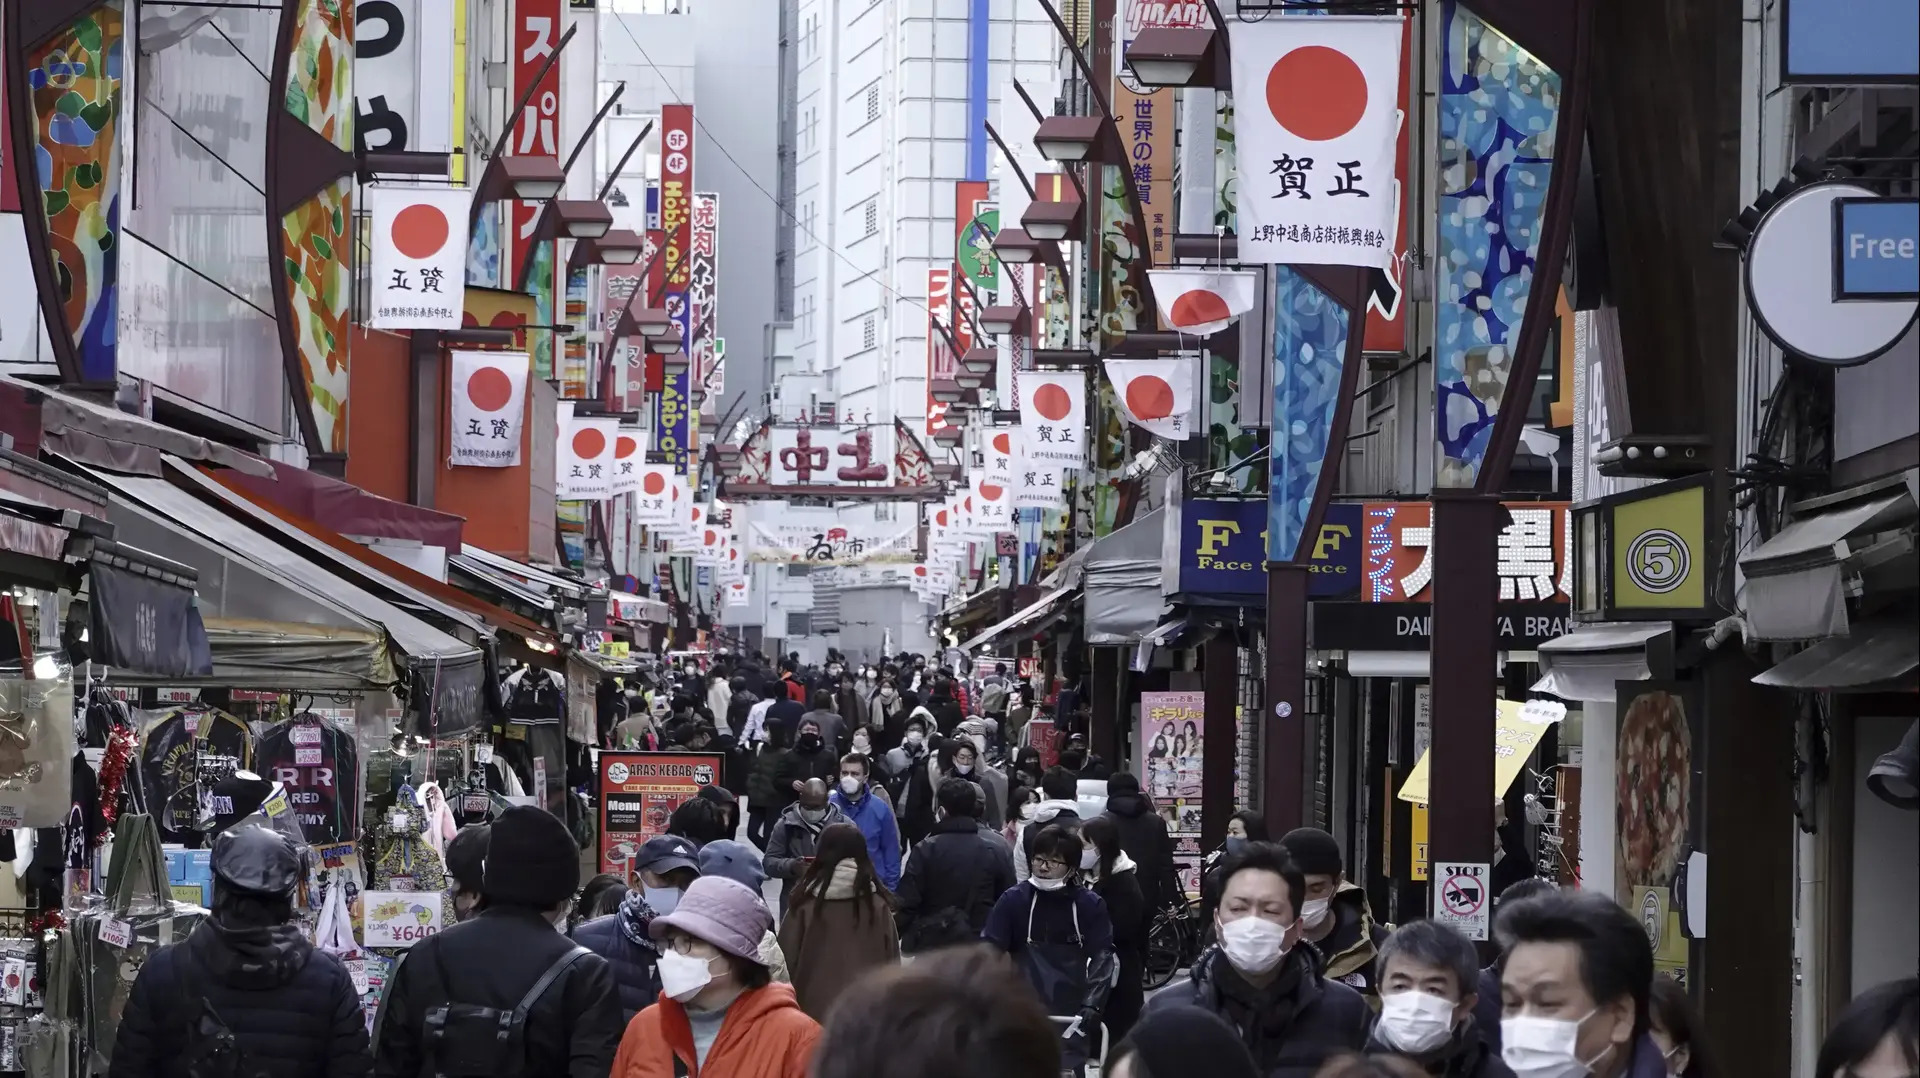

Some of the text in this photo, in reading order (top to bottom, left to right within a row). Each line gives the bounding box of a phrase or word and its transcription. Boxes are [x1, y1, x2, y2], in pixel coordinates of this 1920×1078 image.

[670, 134, 685, 147] 5F
[1133, 99, 1153, 204] 世界の雑貨
[669, 158, 684, 170] 4F
[1269, 153, 1370, 200] 賀正
[1251, 224, 1385, 248] 上野中通商店街振興組合
[1850, 233, 1914, 259] Free
[1037, 424, 1075, 443] 賀正
[1196, 519, 1241, 555] F
[1312, 524, 1352, 559] F
[1369, 507, 1395, 602] ブランド
[1643, 544, 1675, 579] 5
[1198, 556, 1253, 571] Face
[1308, 564, 1347, 574] ace
[629, 764, 656, 776] ARAS
[659, 764, 693, 777] KEBAB
[292, 793, 319, 803] RED
[608, 801, 641, 811] Menu
[297, 814, 327, 825] RMY
[1446, 866, 1483, 876] STOP
